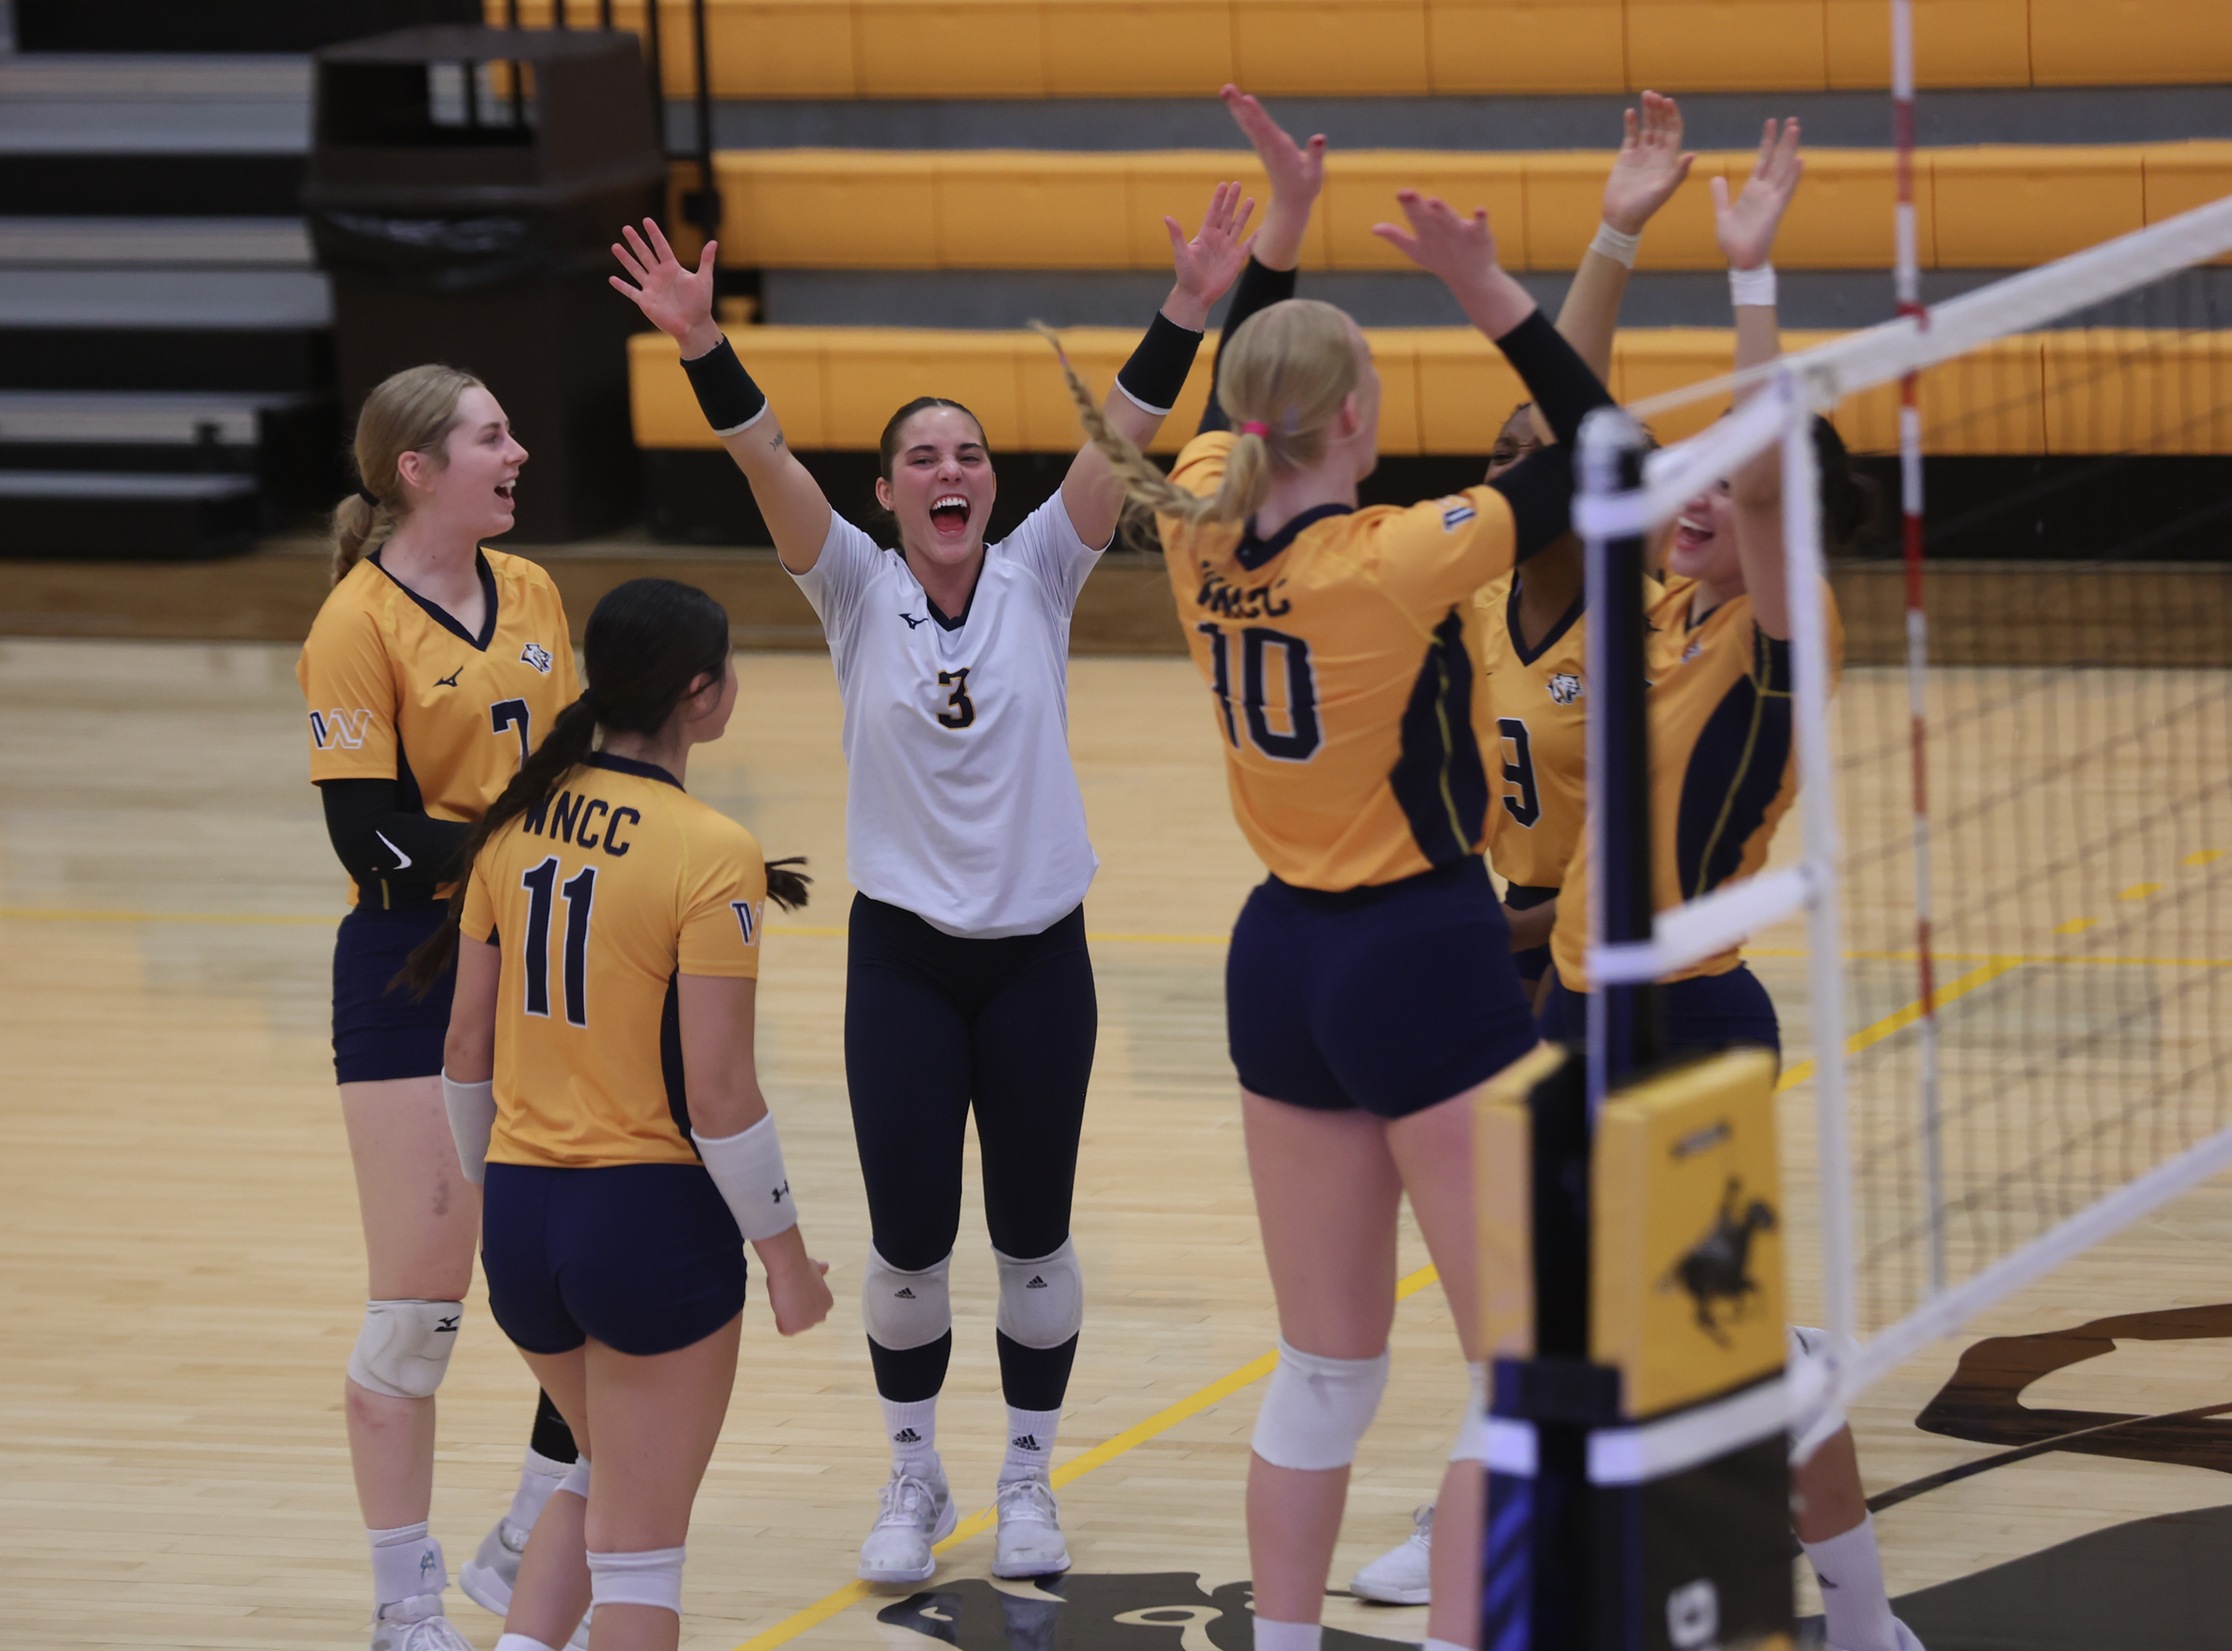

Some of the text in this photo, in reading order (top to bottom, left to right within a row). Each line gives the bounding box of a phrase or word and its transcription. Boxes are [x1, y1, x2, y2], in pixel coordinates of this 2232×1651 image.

[490, 697, 530, 773] 7
[937, 667, 977, 730] 3
[1196, 621, 1325, 764] 10
[1496, 717, 1541, 829] 9
[522, 787, 641, 857] WNCC
[521, 854, 598, 1029] 11
